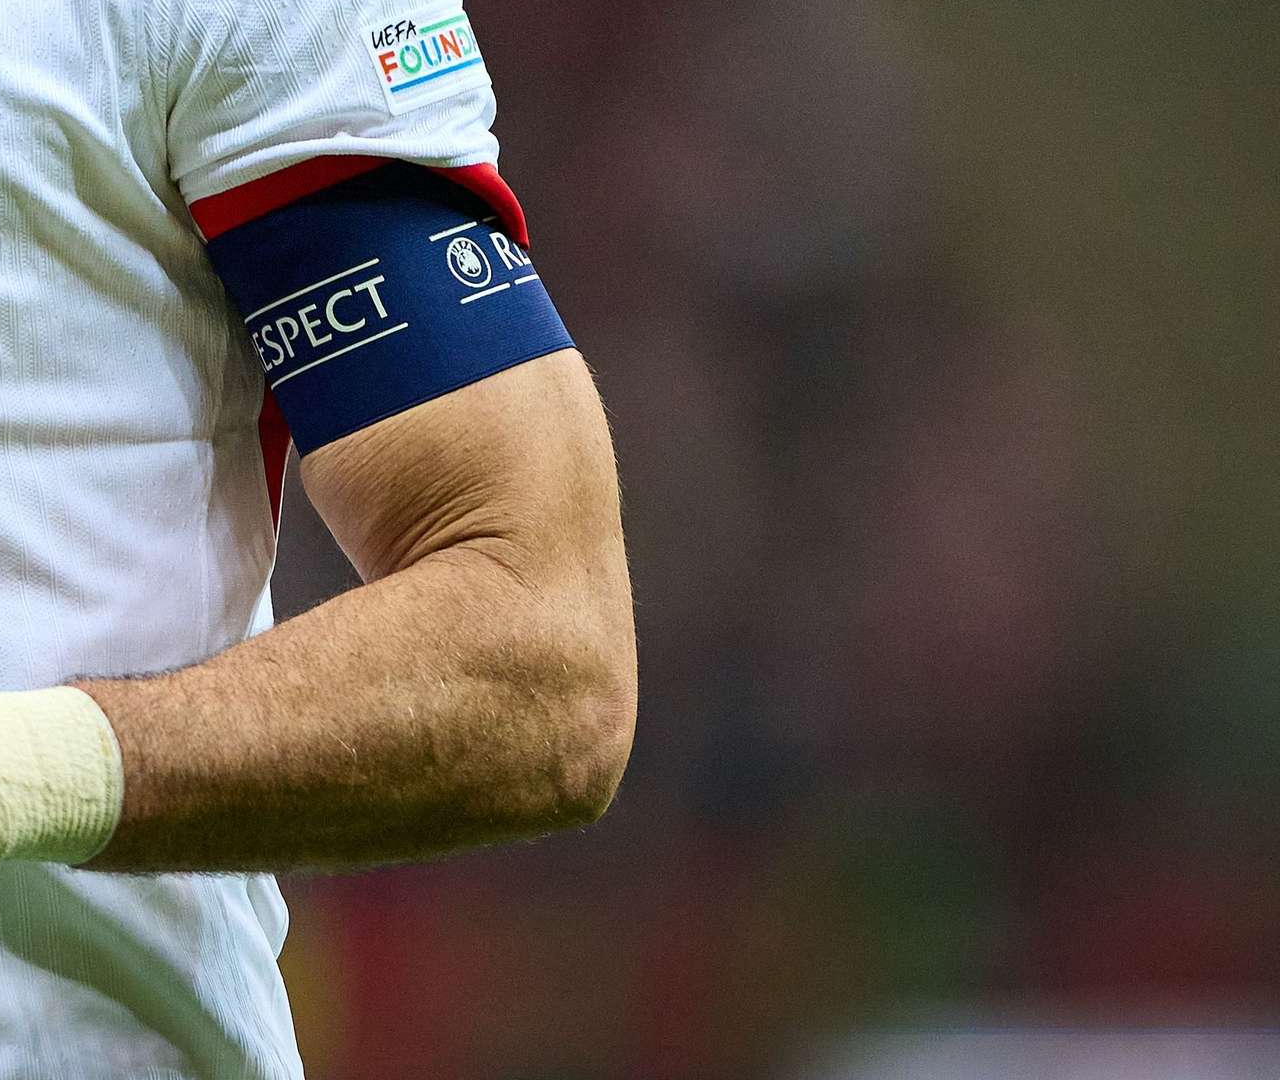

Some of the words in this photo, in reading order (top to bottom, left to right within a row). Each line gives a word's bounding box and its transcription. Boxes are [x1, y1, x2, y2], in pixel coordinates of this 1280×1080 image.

[371, 20, 417, 49] UEFA
[378, 26, 478, 83] FOUND
[251, 274, 389, 373] ESPECT
